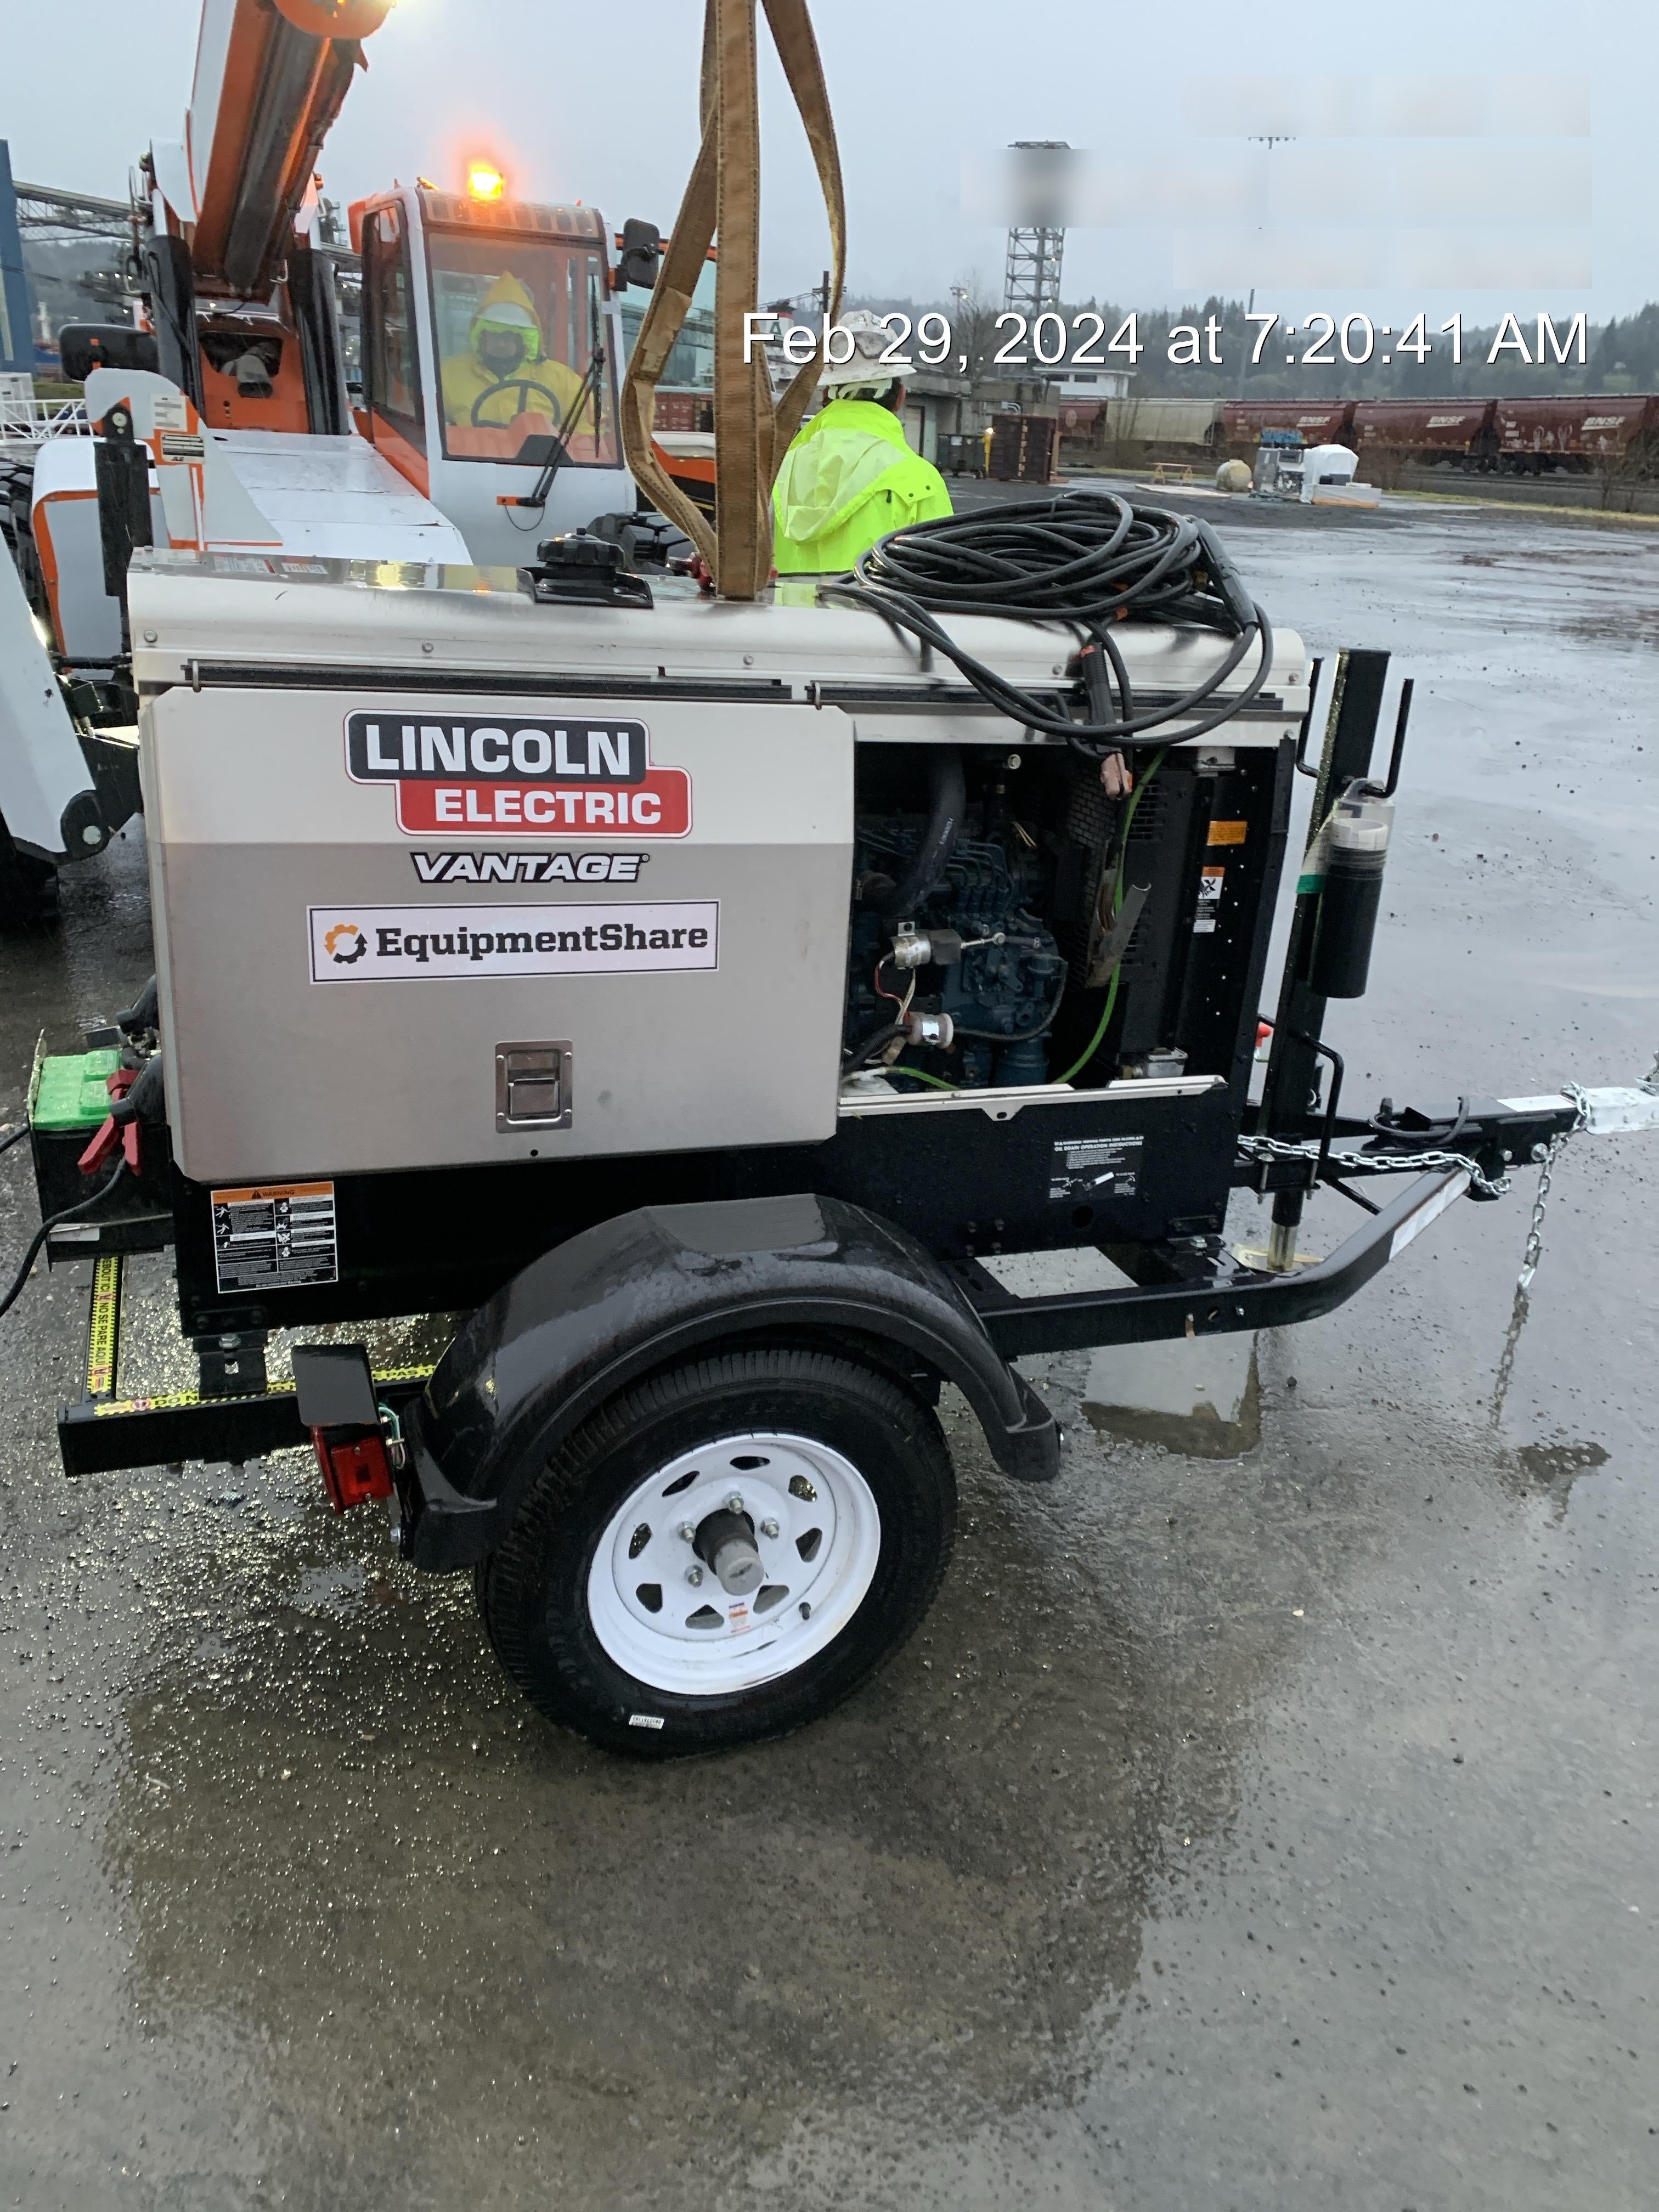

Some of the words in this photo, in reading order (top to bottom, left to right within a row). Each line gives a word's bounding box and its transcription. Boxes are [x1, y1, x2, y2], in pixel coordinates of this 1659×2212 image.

[1584, 416, 1626, 426] BNSF
[366, 724, 630, 776] LINCOLN
[435, 788, 661, 825] ELECTRIC
[410, 853, 642, 882] VANTAGE
[375, 923, 708, 962] EquipmentShare
[100, 1283, 110, 1292] ICI
[99, 1302, 109, 1313] NO
[98, 1314, 108, 1324] SE
[97, 1325, 108, 1345] PARE
